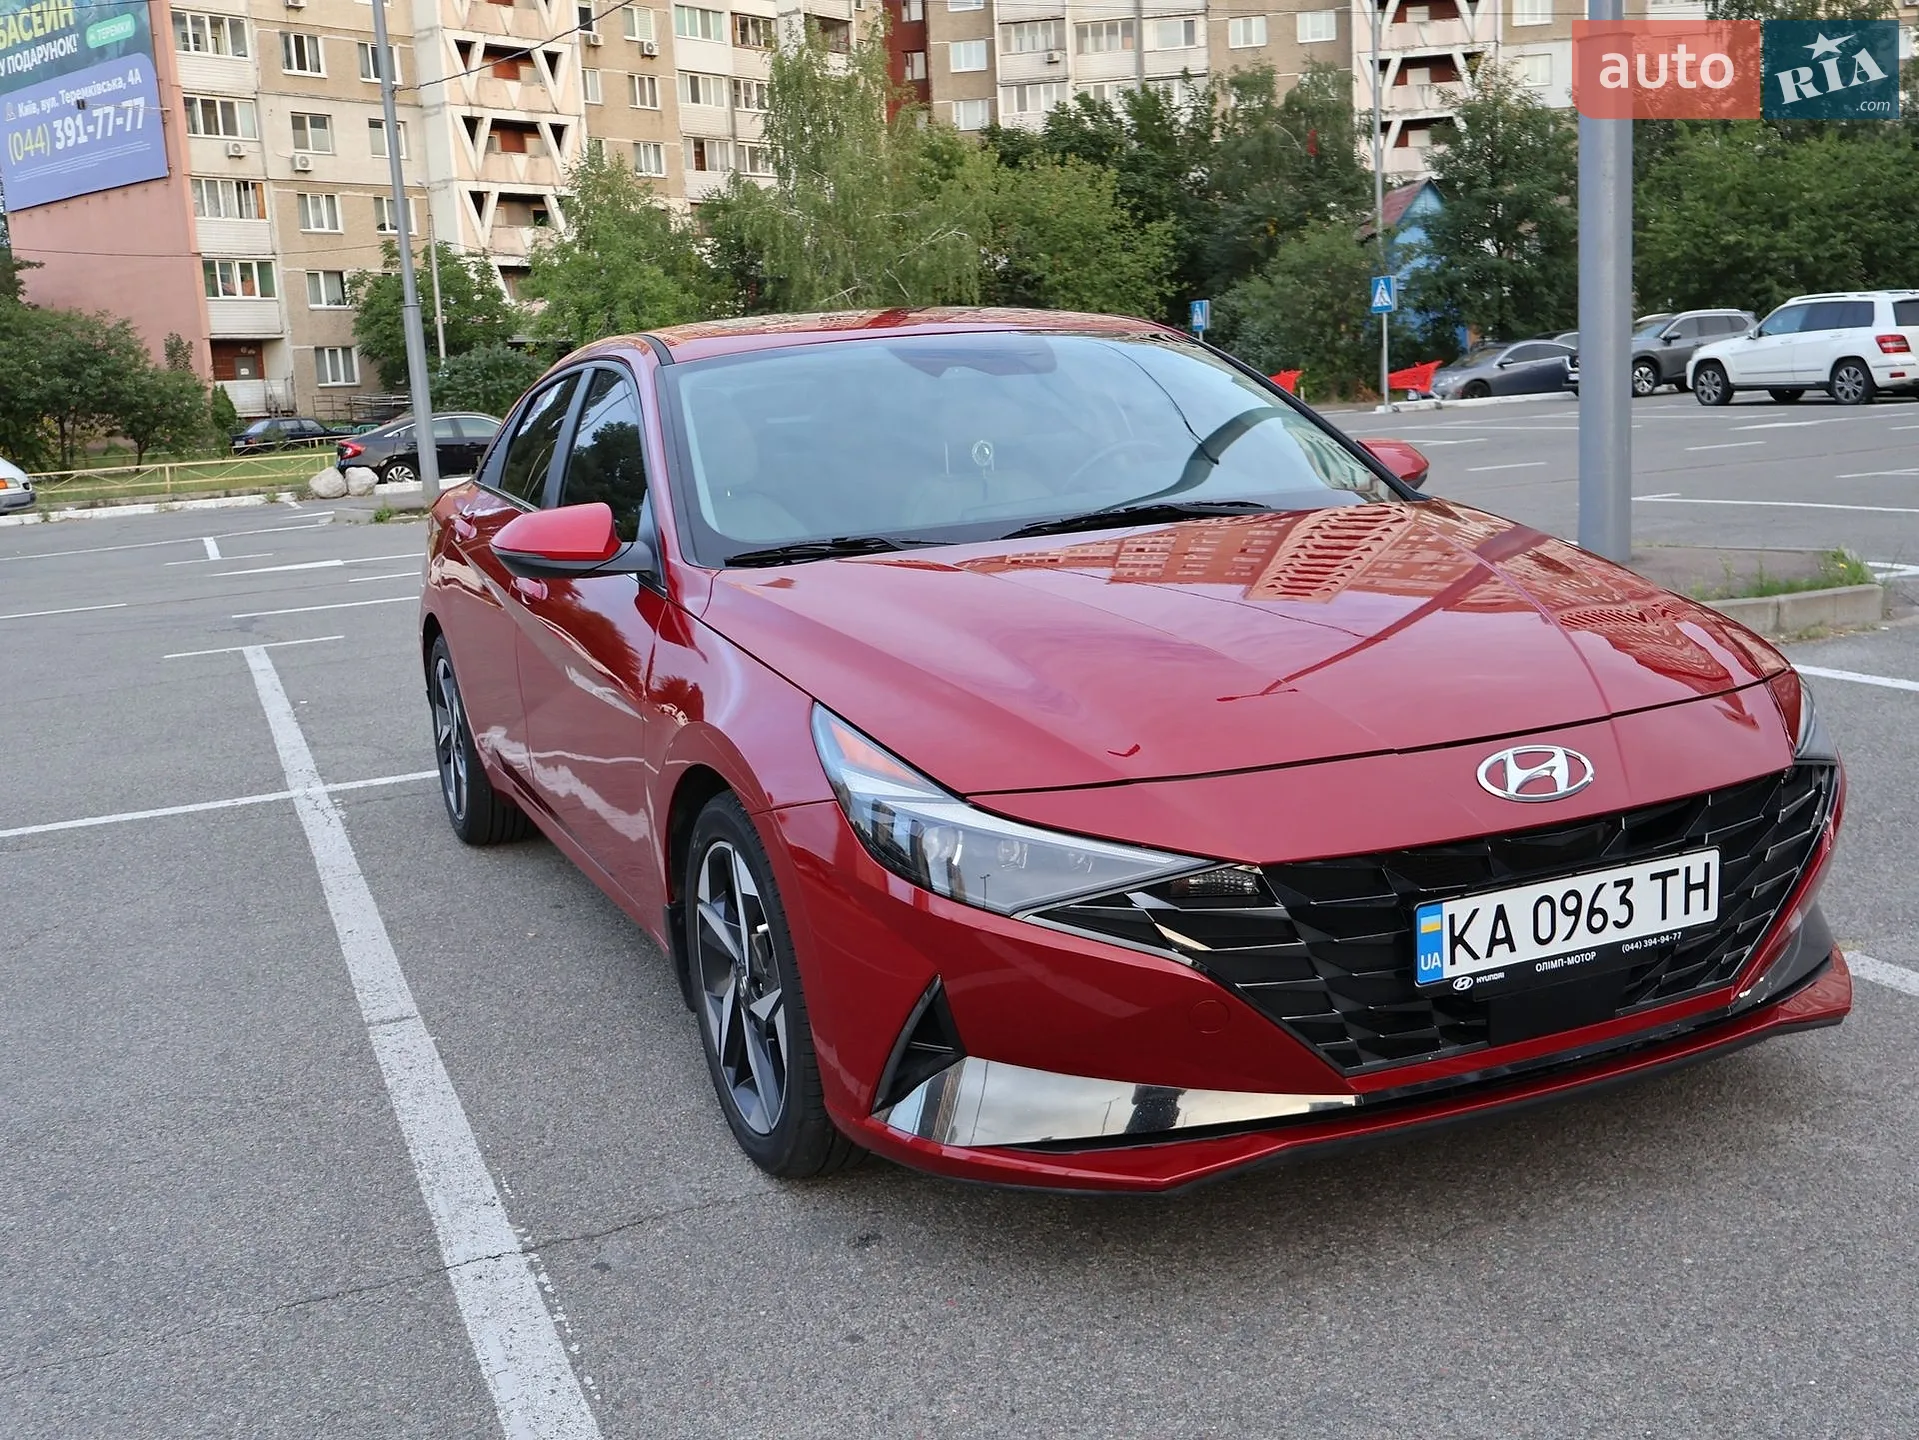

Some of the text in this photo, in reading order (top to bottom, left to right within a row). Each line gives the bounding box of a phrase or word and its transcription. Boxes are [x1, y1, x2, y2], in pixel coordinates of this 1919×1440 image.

[18, 100, 40, 117] Київ,
[40, 96, 59, 113] вул.
[8, 123, 51, 166] (044)
[53, 96, 145, 150] 391-77-77
[1448, 861, 1711, 966] KA 0963 TH
[1622, 932, 1682, 953] (044) 394-94-77
[1420, 952, 1442, 971] UA
[1535, 951, 1597, 972] ОЛІМП-МОТОР
[1476, 972, 1505, 984] HYUNDAI
